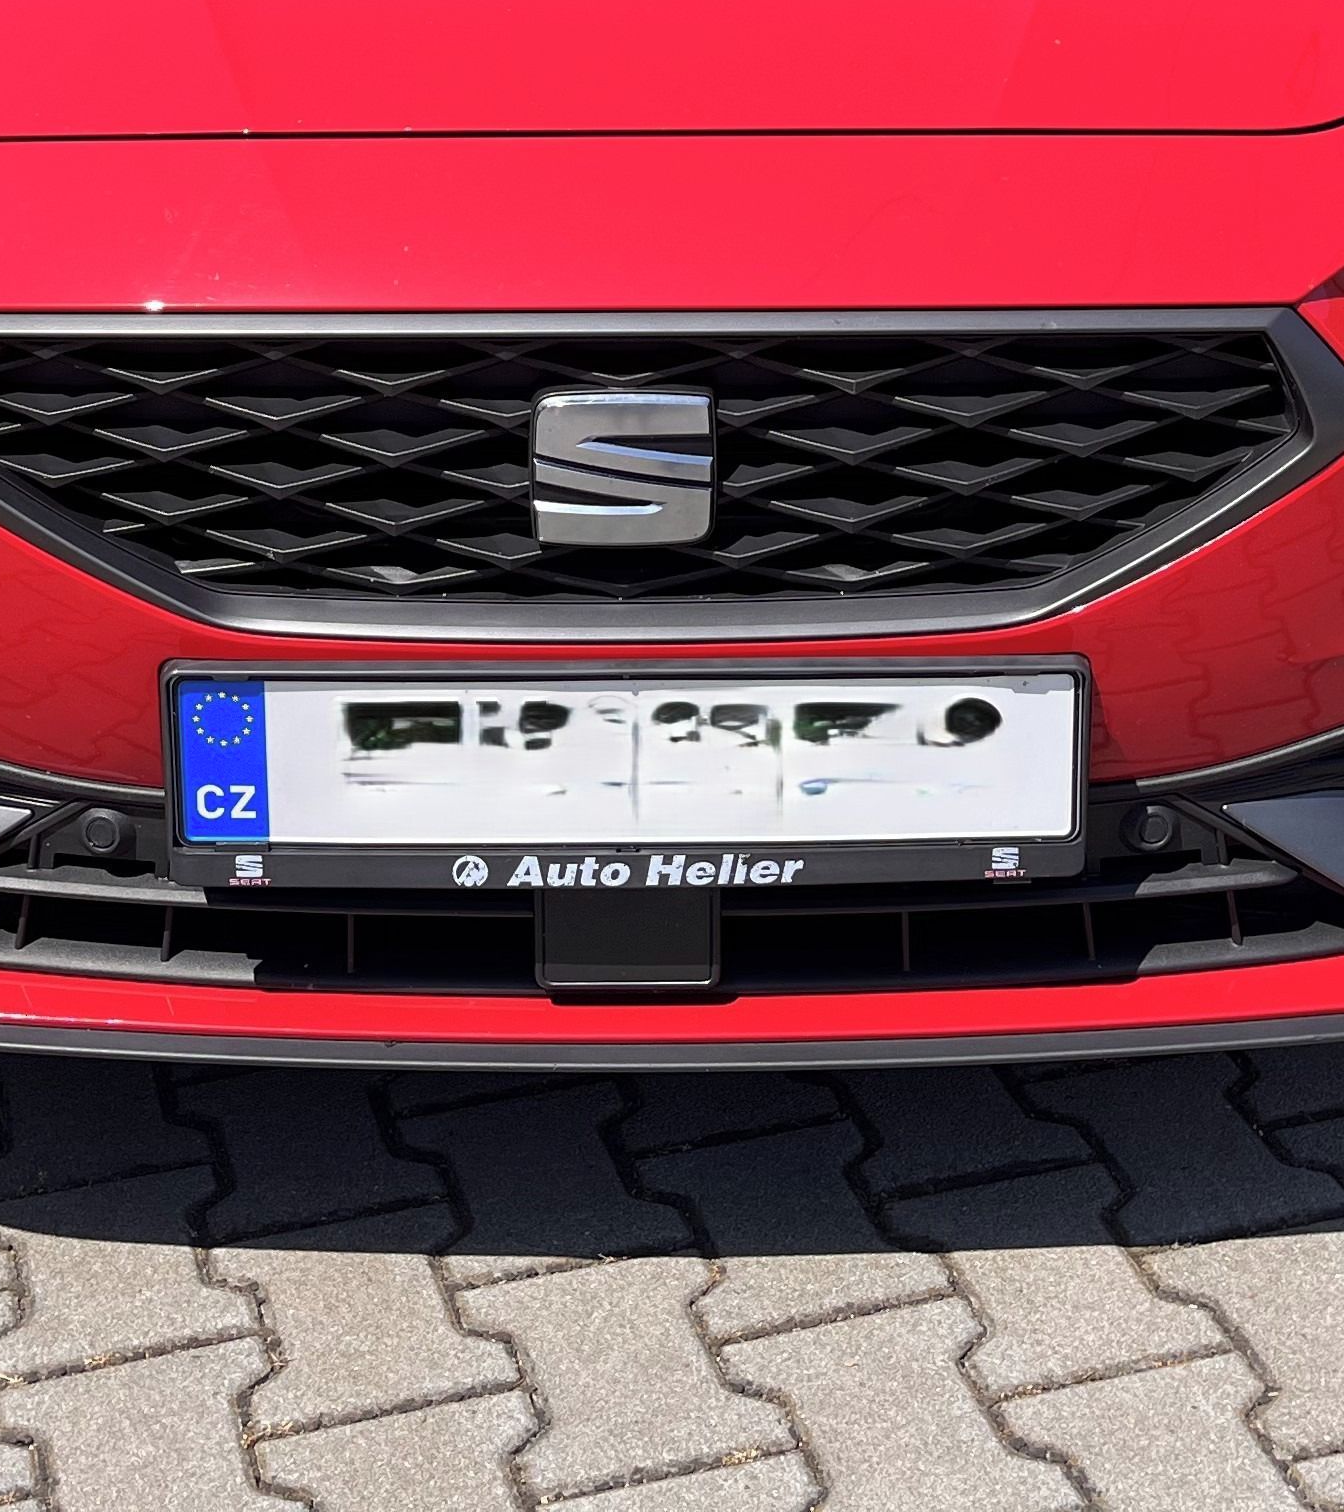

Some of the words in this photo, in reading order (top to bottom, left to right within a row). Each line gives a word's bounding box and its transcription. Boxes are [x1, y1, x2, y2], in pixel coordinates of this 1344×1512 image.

[196, 784, 257, 820] CZ
[228, 878, 272, 887] SEAT
[506, 855, 631, 887] Auto
